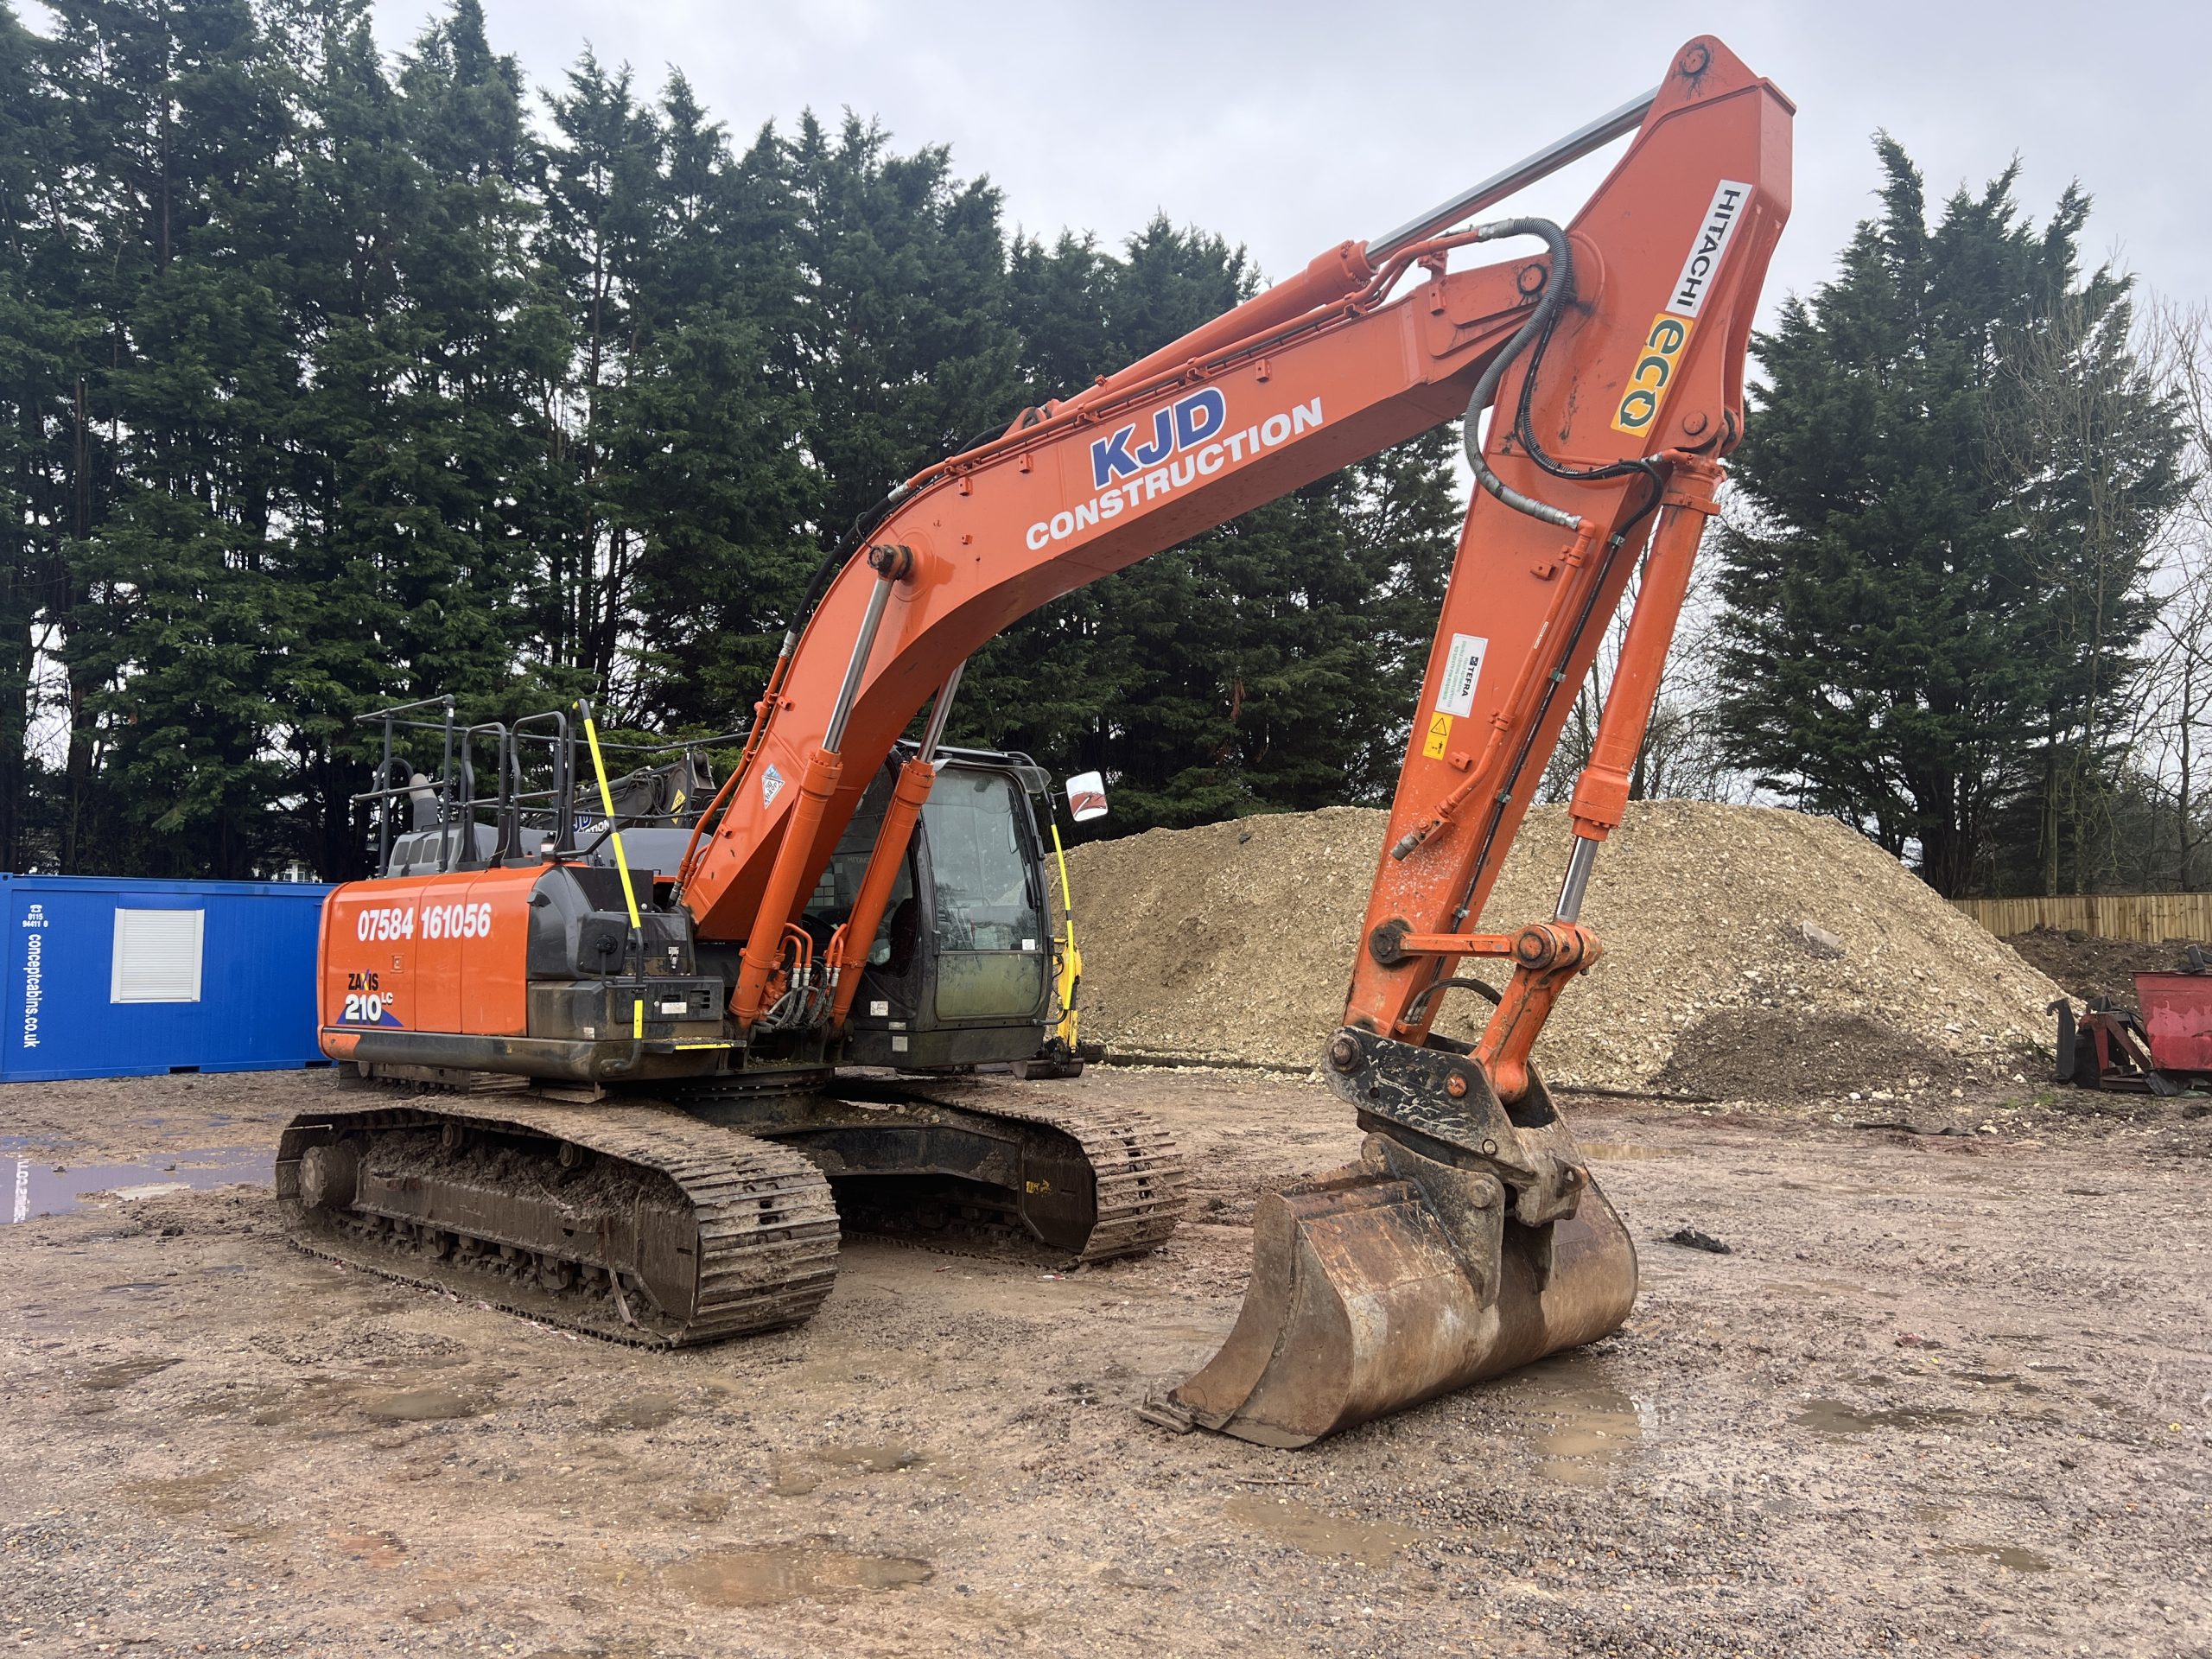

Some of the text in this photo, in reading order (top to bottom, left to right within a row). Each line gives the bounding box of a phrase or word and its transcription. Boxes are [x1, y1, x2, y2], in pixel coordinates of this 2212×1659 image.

[1676, 188, 1741, 307] HITACHI
[1026, 397, 1324, 550] CONSTRUCTION
[1090, 386, 1226, 490] KJD
[1462, 667, 1474, 696] TEFRA
[358, 902, 492, 942] 07584 161056
[23, 934, 42, 1048] conceptcabins.co.uk
[345, 993, 382, 1022] 210
[348, 969, 378, 991] ZAXIS
